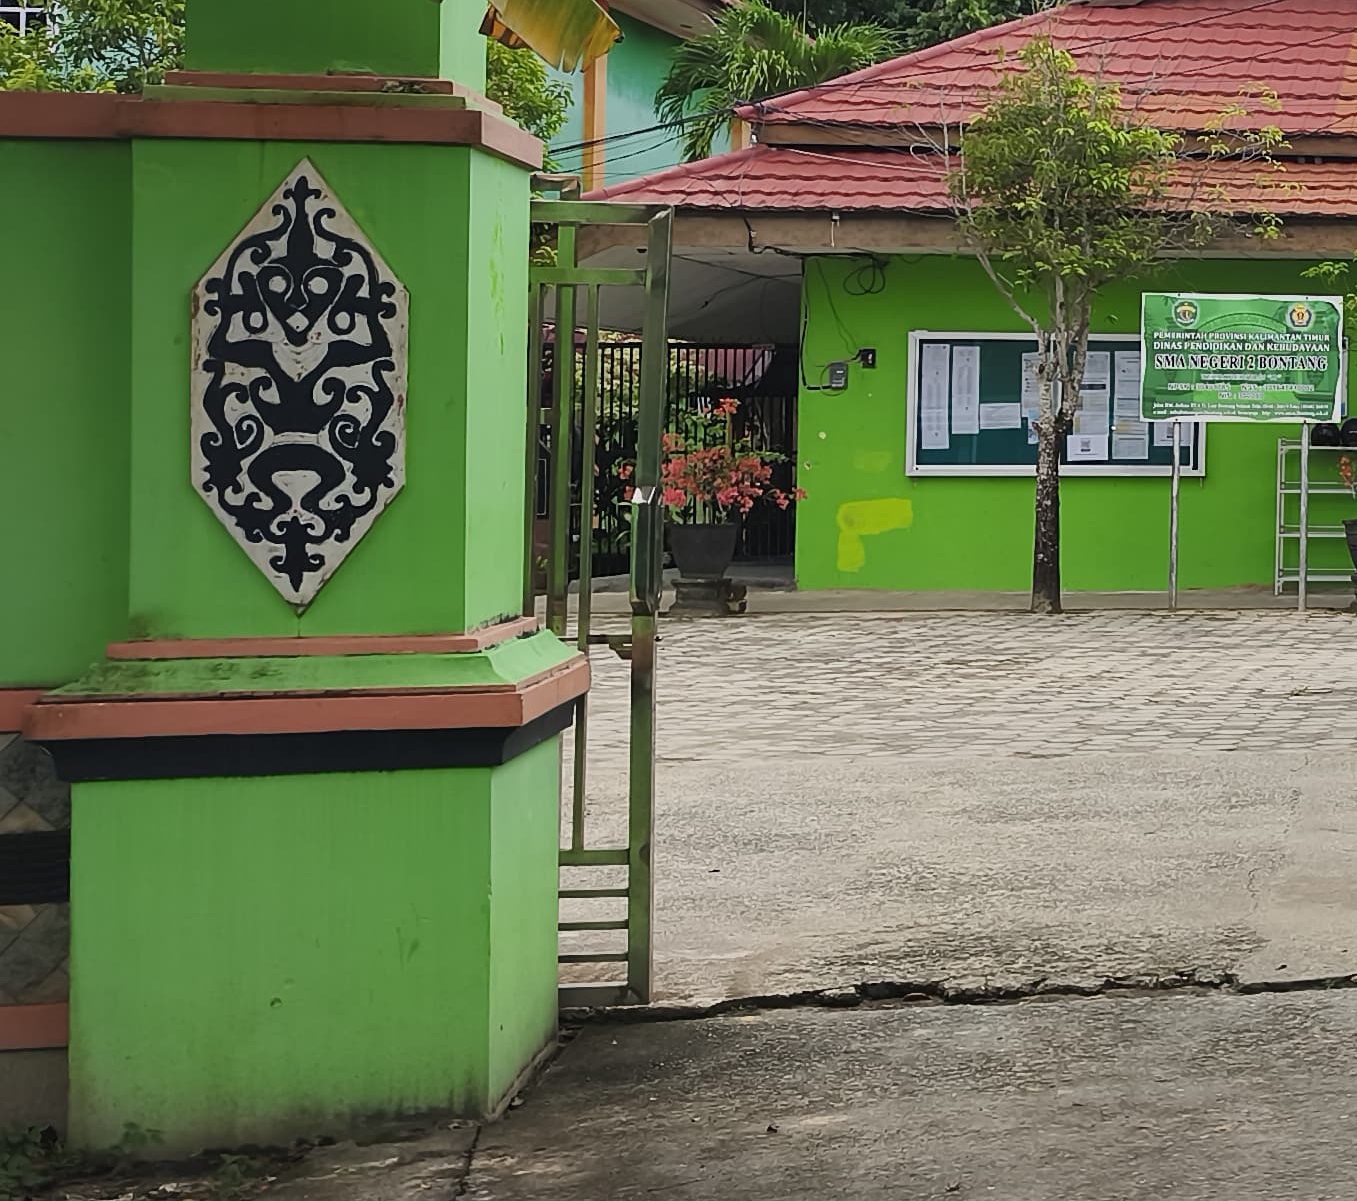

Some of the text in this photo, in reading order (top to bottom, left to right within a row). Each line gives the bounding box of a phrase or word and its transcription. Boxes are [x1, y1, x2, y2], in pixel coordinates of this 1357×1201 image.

[1185, 342, 1242, 350] PENDIDIKAN
[1155, 355, 1327, 370] SMA NEGERI 2 BONTANG
